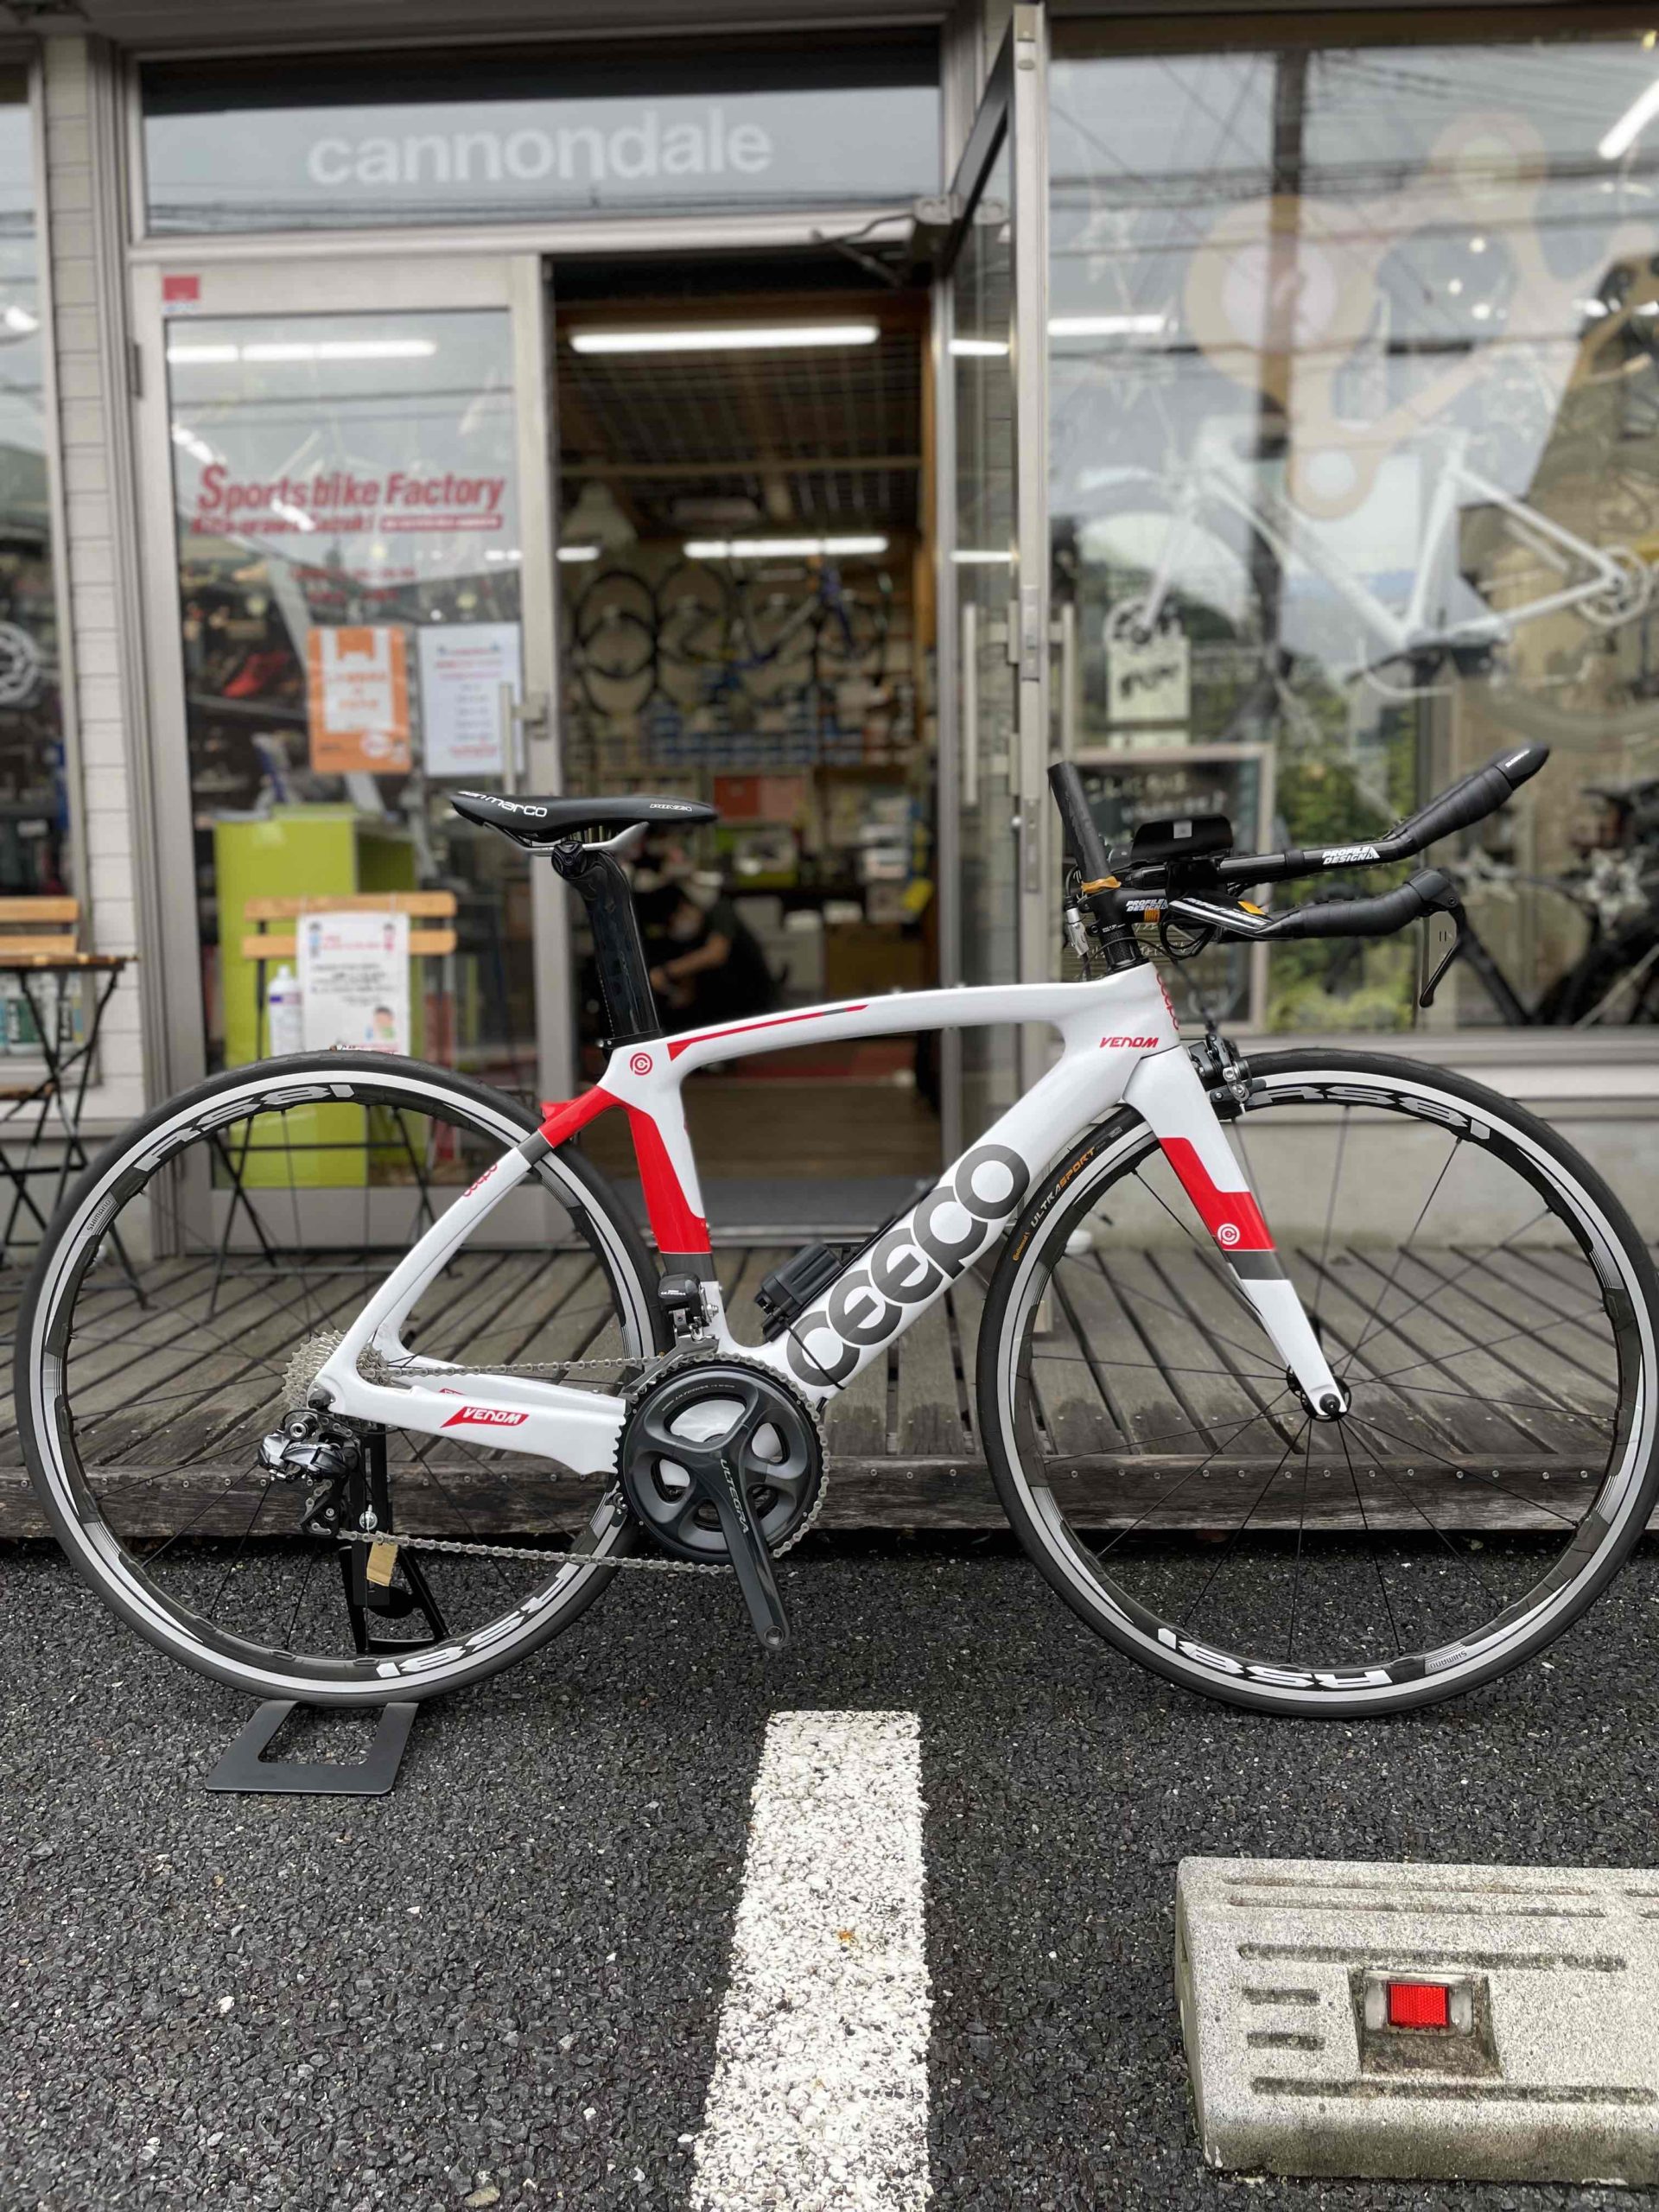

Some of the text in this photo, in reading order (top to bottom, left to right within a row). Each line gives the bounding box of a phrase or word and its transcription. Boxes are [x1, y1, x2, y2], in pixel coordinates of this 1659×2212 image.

[307, 105, 774, 186] cannondale
[385, 473, 505, 512] Factory
[486, 796, 548, 817] marco
[1322, 846, 1371, 858] PROFILE
[1322, 853, 1367, 865] DESIGN
[1126, 899, 1165, 907] PROFILE
[1099, 1037, 1159, 1048] VENOM
[86, 1199, 111, 1231] SHIMANO
[786, 1144, 1031, 1387] ceepo
[462, 1408, 523, 1424] VENOM
[720, 1458, 749, 1535] ULTEGRA
[1429, 1649, 1467, 1669] SHIMANO
